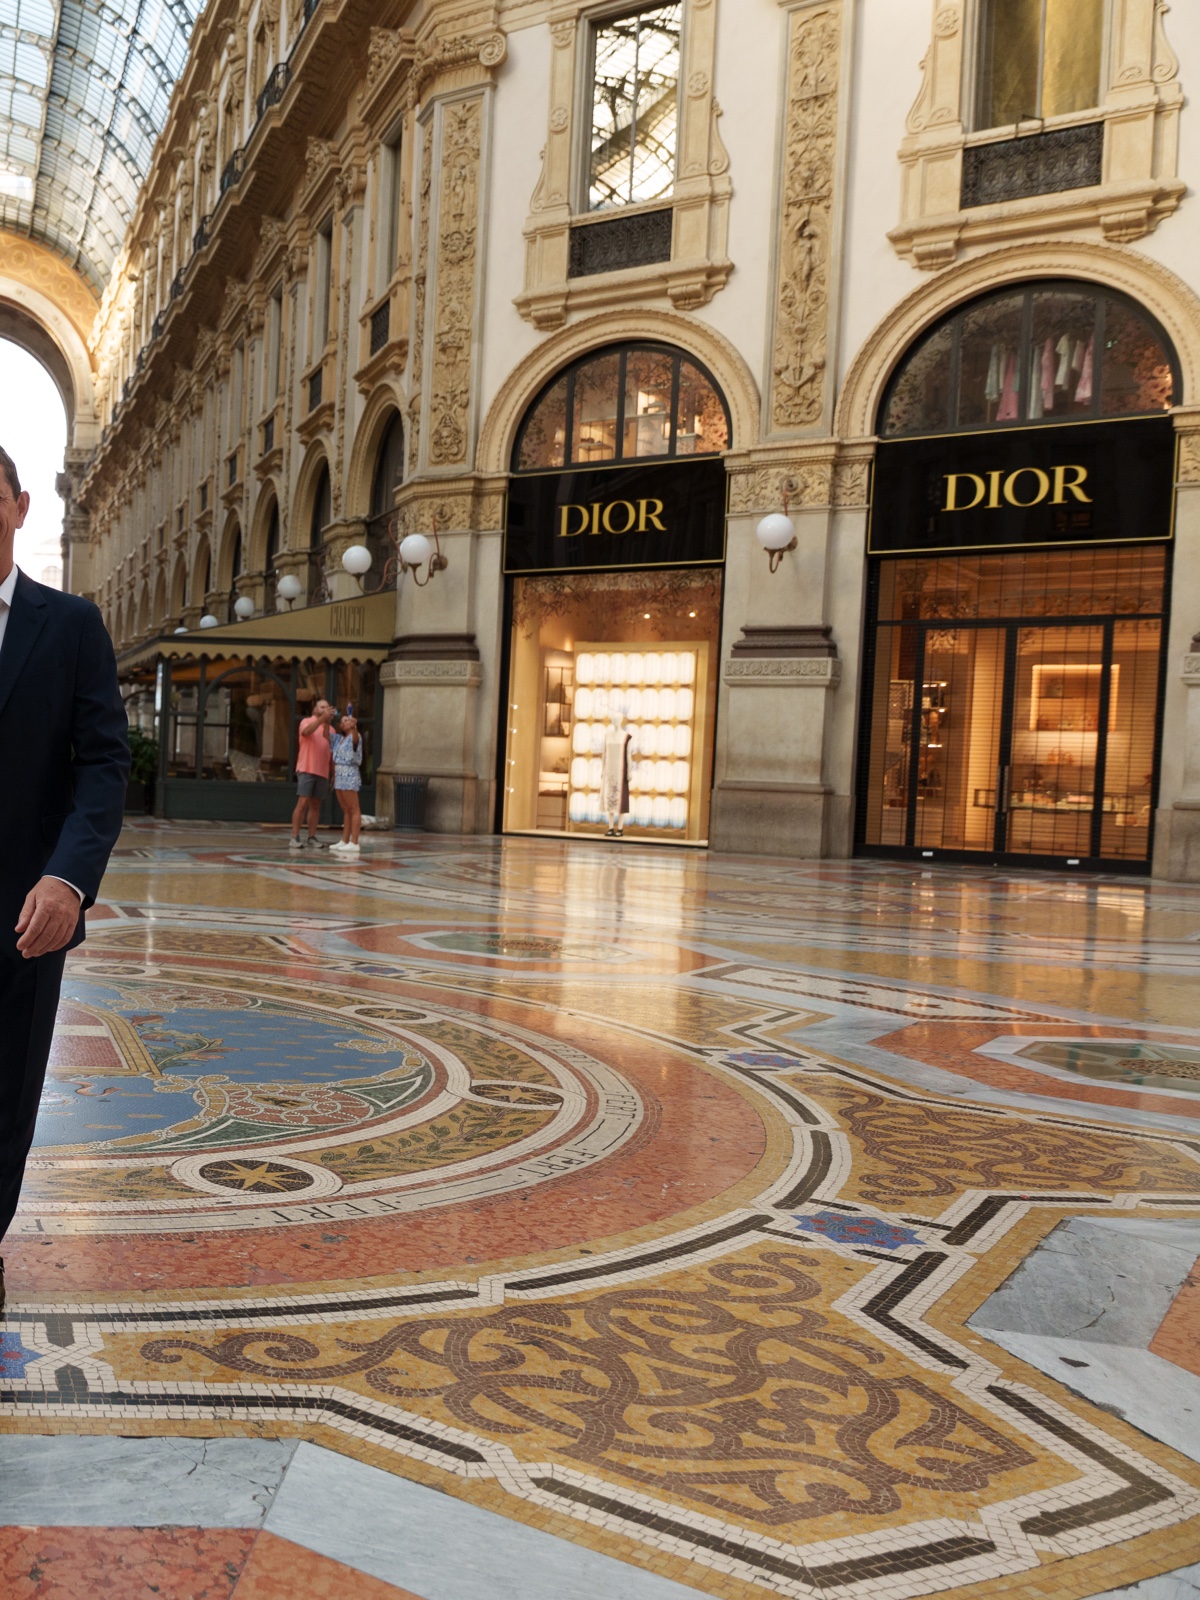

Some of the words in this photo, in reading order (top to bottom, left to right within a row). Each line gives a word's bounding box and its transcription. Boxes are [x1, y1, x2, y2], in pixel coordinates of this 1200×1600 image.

[940, 465, 1093, 511] DIOR
[557, 498, 667, 537] DIOR
[604, 1093, 637, 1119] FERT
[518, 1148, 599, 1178] FERT
[271, 1199, 400, 1223] FERT
